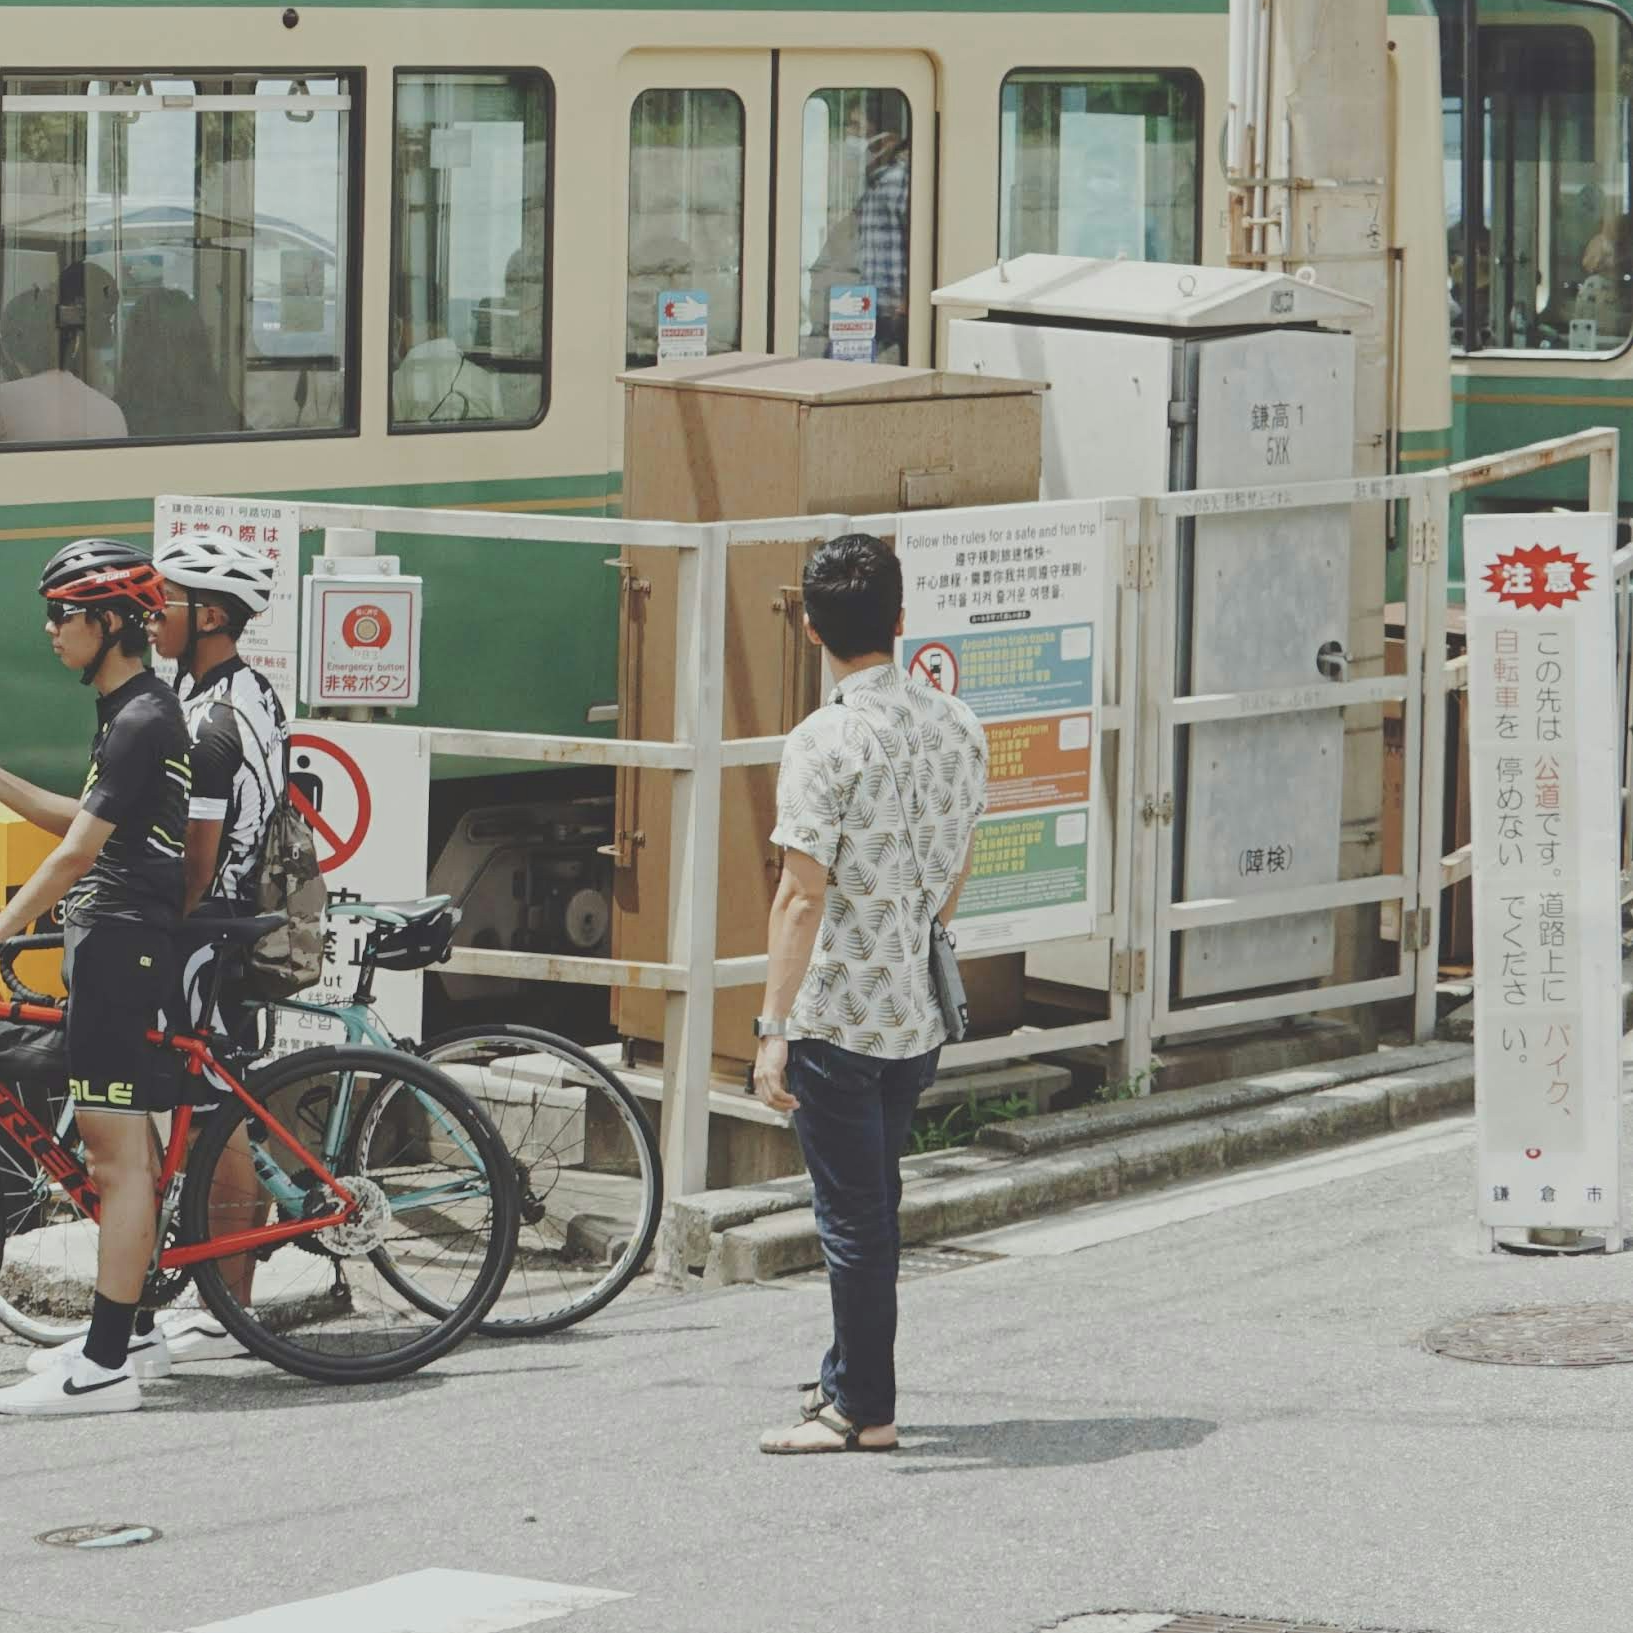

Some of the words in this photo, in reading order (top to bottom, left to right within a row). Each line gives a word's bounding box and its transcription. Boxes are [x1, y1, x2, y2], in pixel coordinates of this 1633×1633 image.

[1250, 401, 1290, 431] 鎌高
[1296, 404, 1304, 425] 1
[906, 533, 939, 549] Follow
[942, 531, 959, 546] the
[961, 529, 986, 544] rules
[989, 527, 1004, 542] for
[1006, 530, 1013, 541] a
[1015, 525, 1035, 539] safe
[1038, 522, 1057, 537] and
[1060, 521, 1076, 536] fun
[1079, 520, 1096, 536] trip
[1502, 561, 1575, 594] 注意
[327, 662, 373, 673] Emergency
[377, 661, 405, 671] button
[325, 674, 406, 692] 非常ボタン
